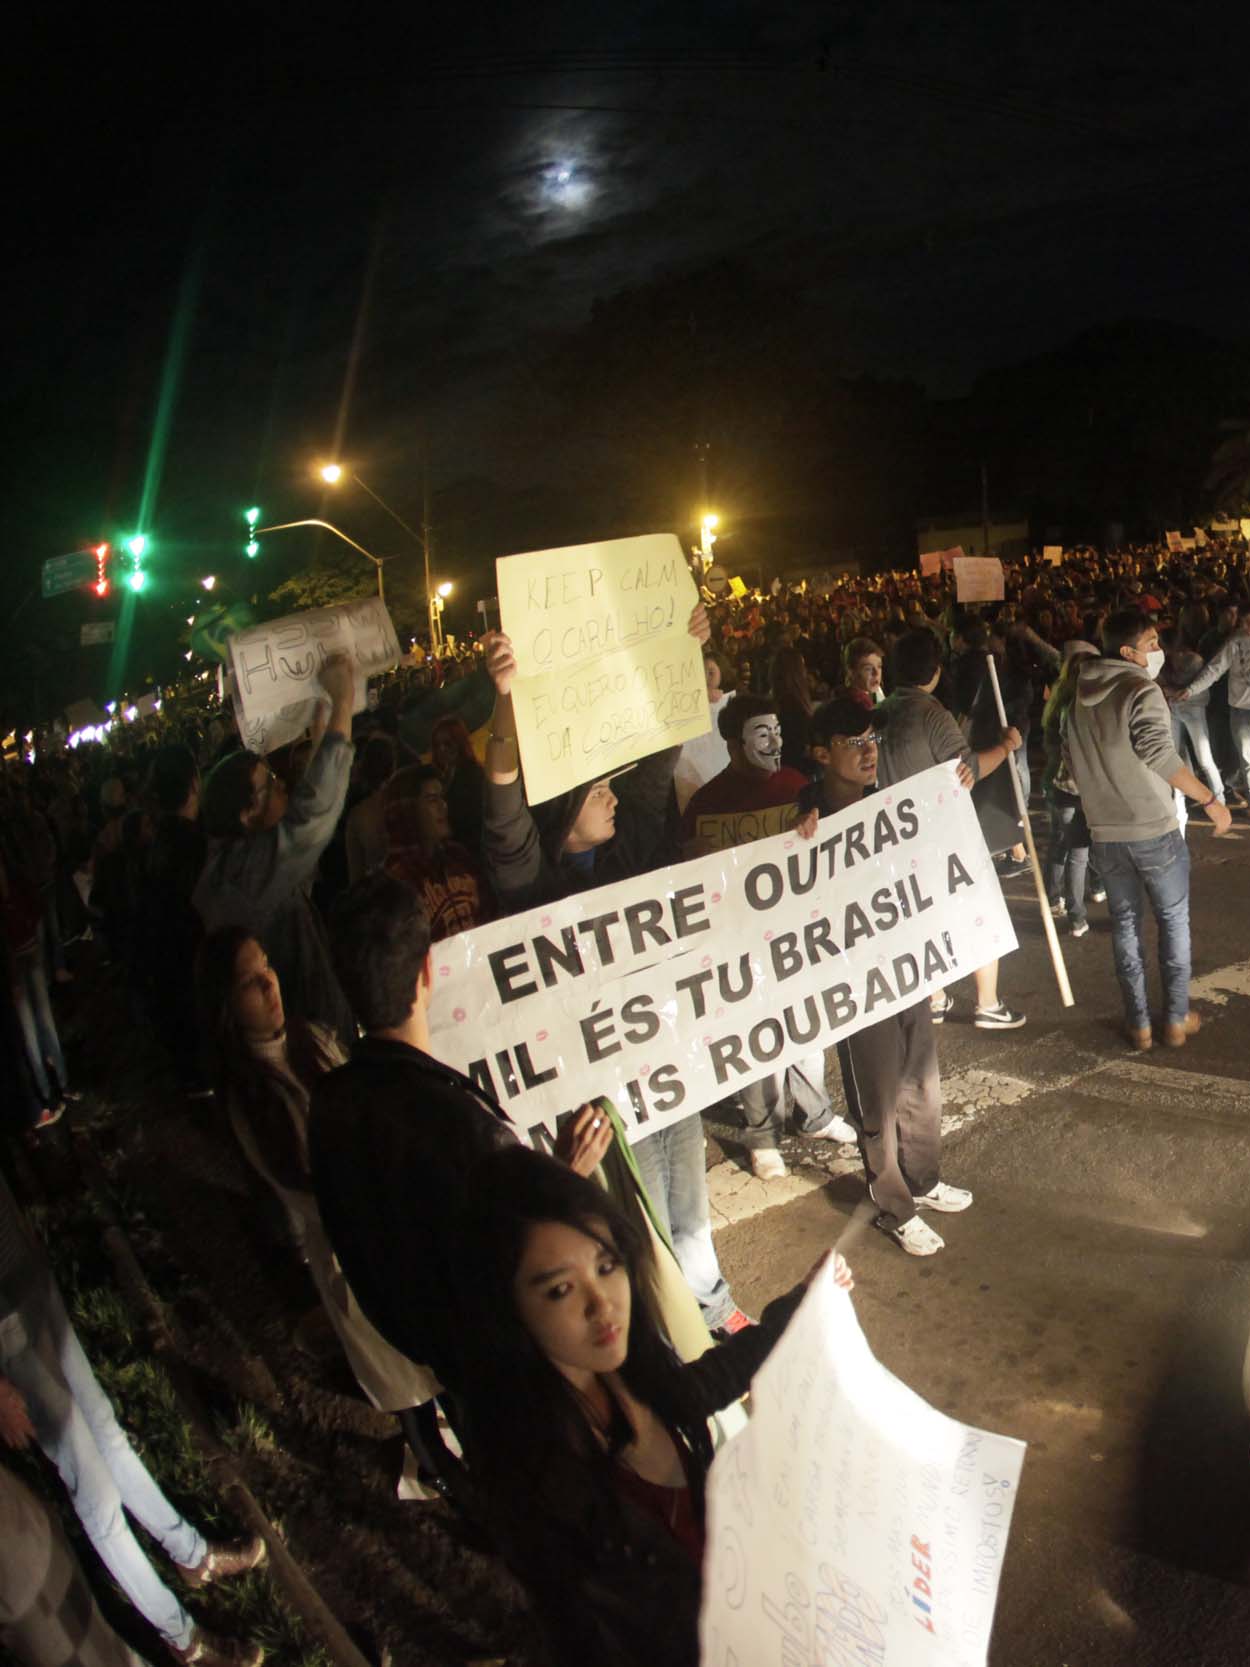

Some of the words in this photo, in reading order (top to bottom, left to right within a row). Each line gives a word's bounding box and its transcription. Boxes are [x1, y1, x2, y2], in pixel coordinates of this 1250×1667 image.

[527, 568, 604, 611] KEEP
[620, 560, 678, 592] CALM
[487, 883, 711, 1005] ENTRE
[743, 798, 920, 912] OUTRAS
[580, 992, 662, 1064] ÉS
[677, 953, 753, 1018] TU
[770, 874, 933, 982] BRASIL
[947, 853, 975, 896] A
[708, 930, 960, 1085] ROUBADA!
[904, 1533, 936, 1636] LÍDER
